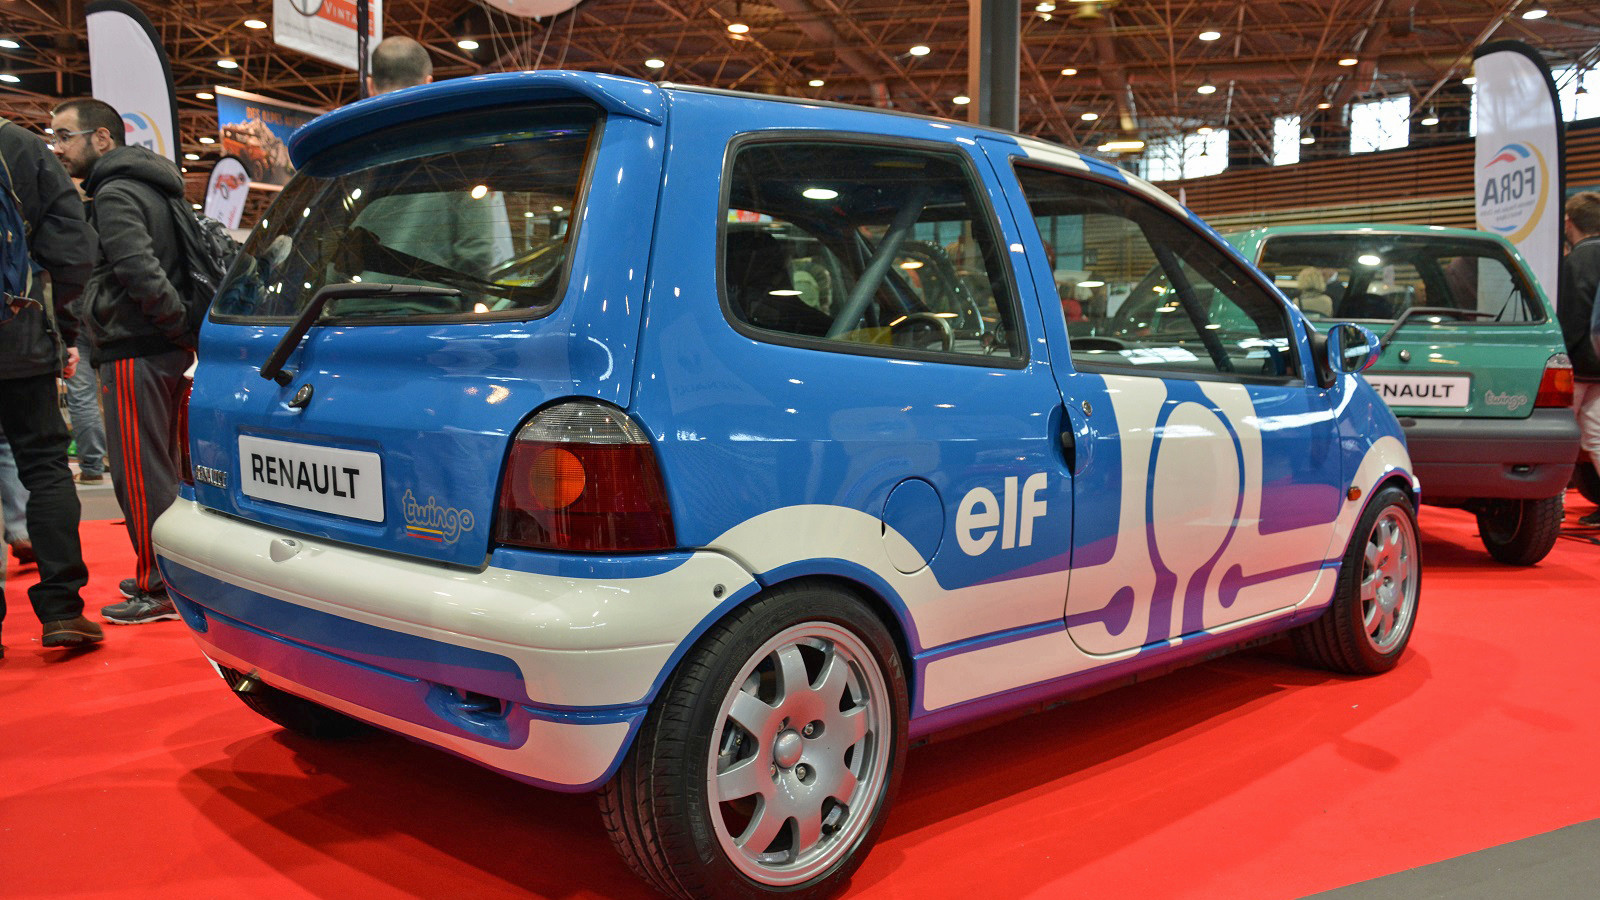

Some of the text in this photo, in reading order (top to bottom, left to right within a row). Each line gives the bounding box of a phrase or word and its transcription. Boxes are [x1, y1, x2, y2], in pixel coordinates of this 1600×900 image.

[323, 0, 375, 31] VINTAE
[1370, 383, 1455, 398] NAULT
[252, 453, 360, 499] RENAULT
[402, 488, 474, 544] twingo
[956, 472, 1047, 556] elf
